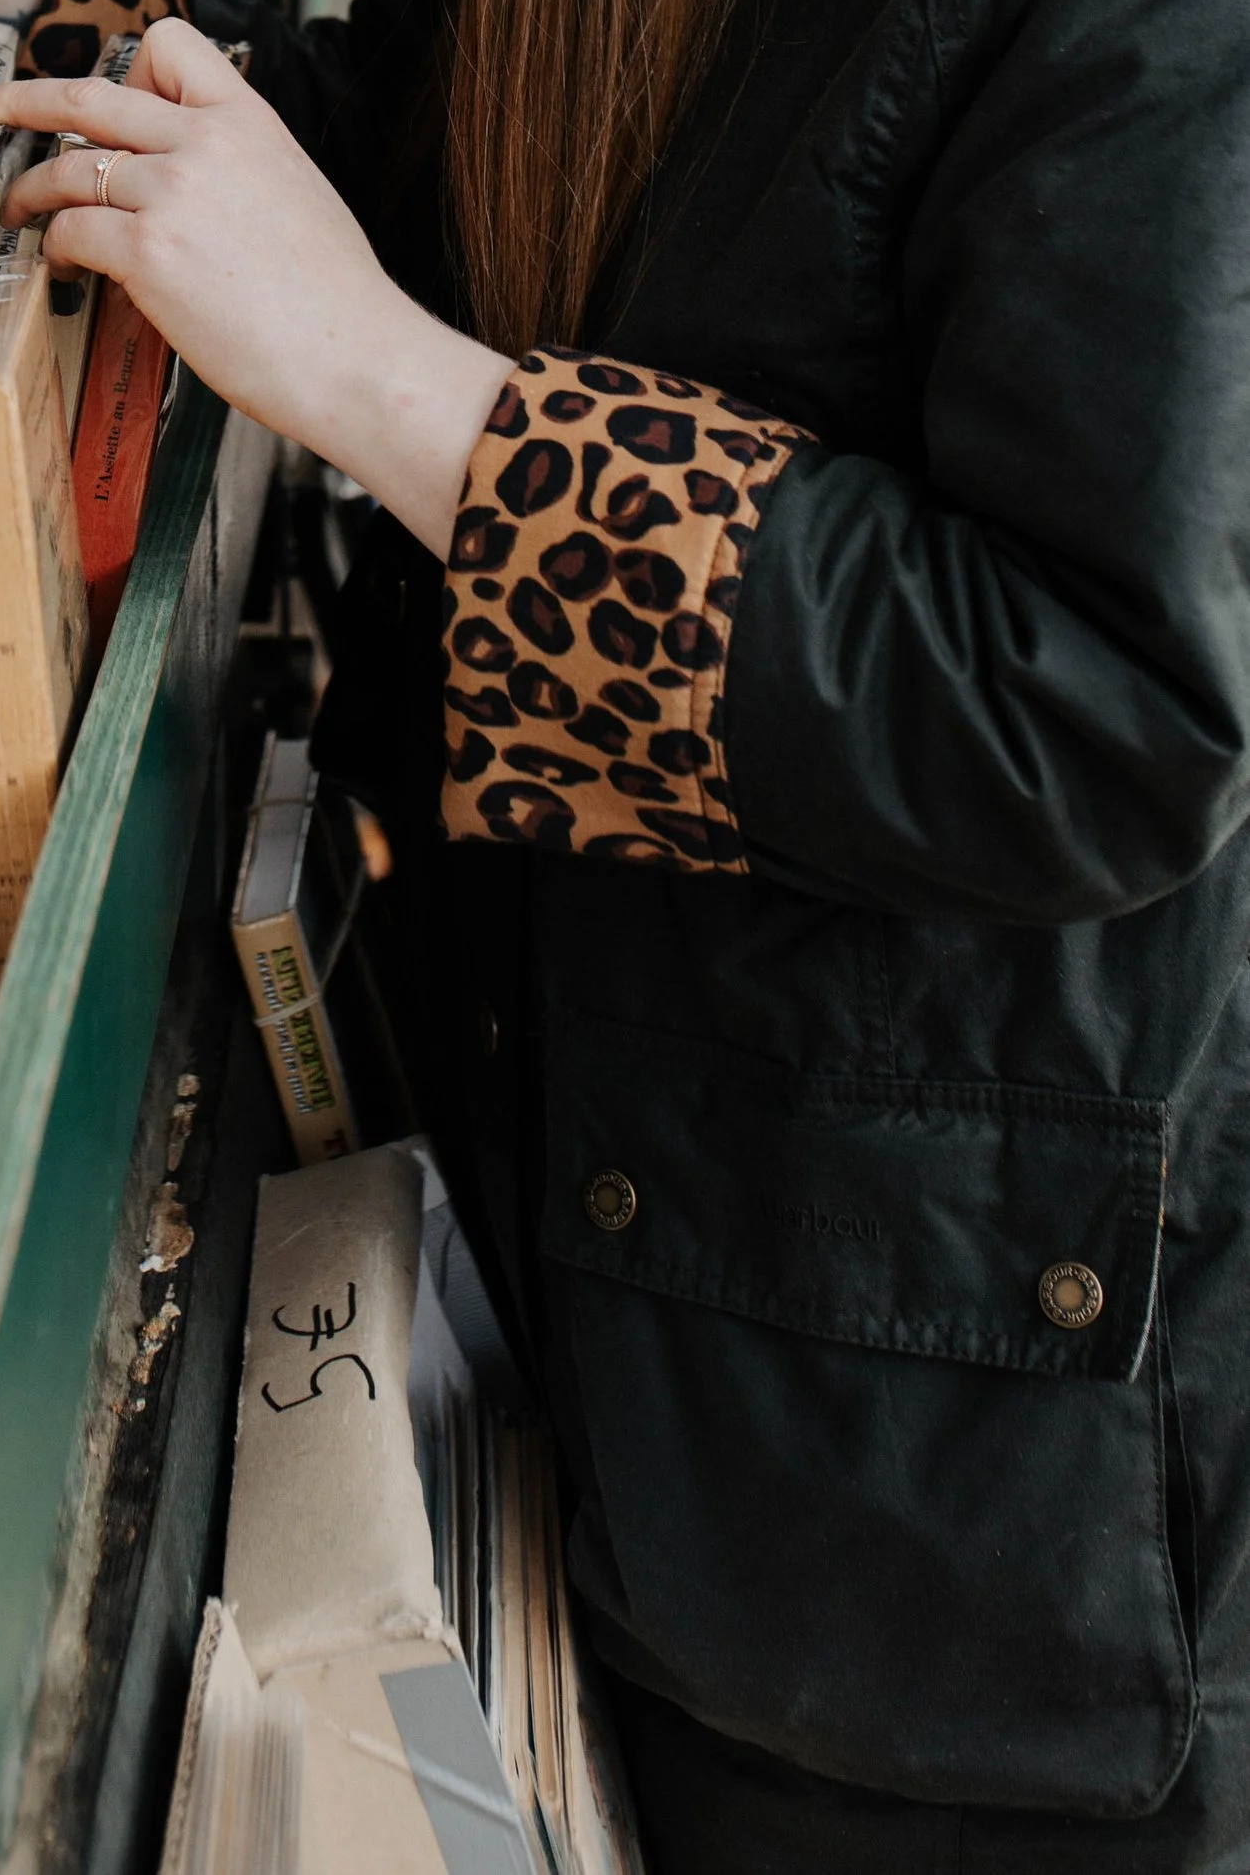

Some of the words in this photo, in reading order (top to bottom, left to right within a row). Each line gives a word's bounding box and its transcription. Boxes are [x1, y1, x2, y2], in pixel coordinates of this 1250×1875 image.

[113, 337, 137, 395] Beurre
[113, 400, 127, 422] au
[94, 425, 121, 503] L'Assiette
